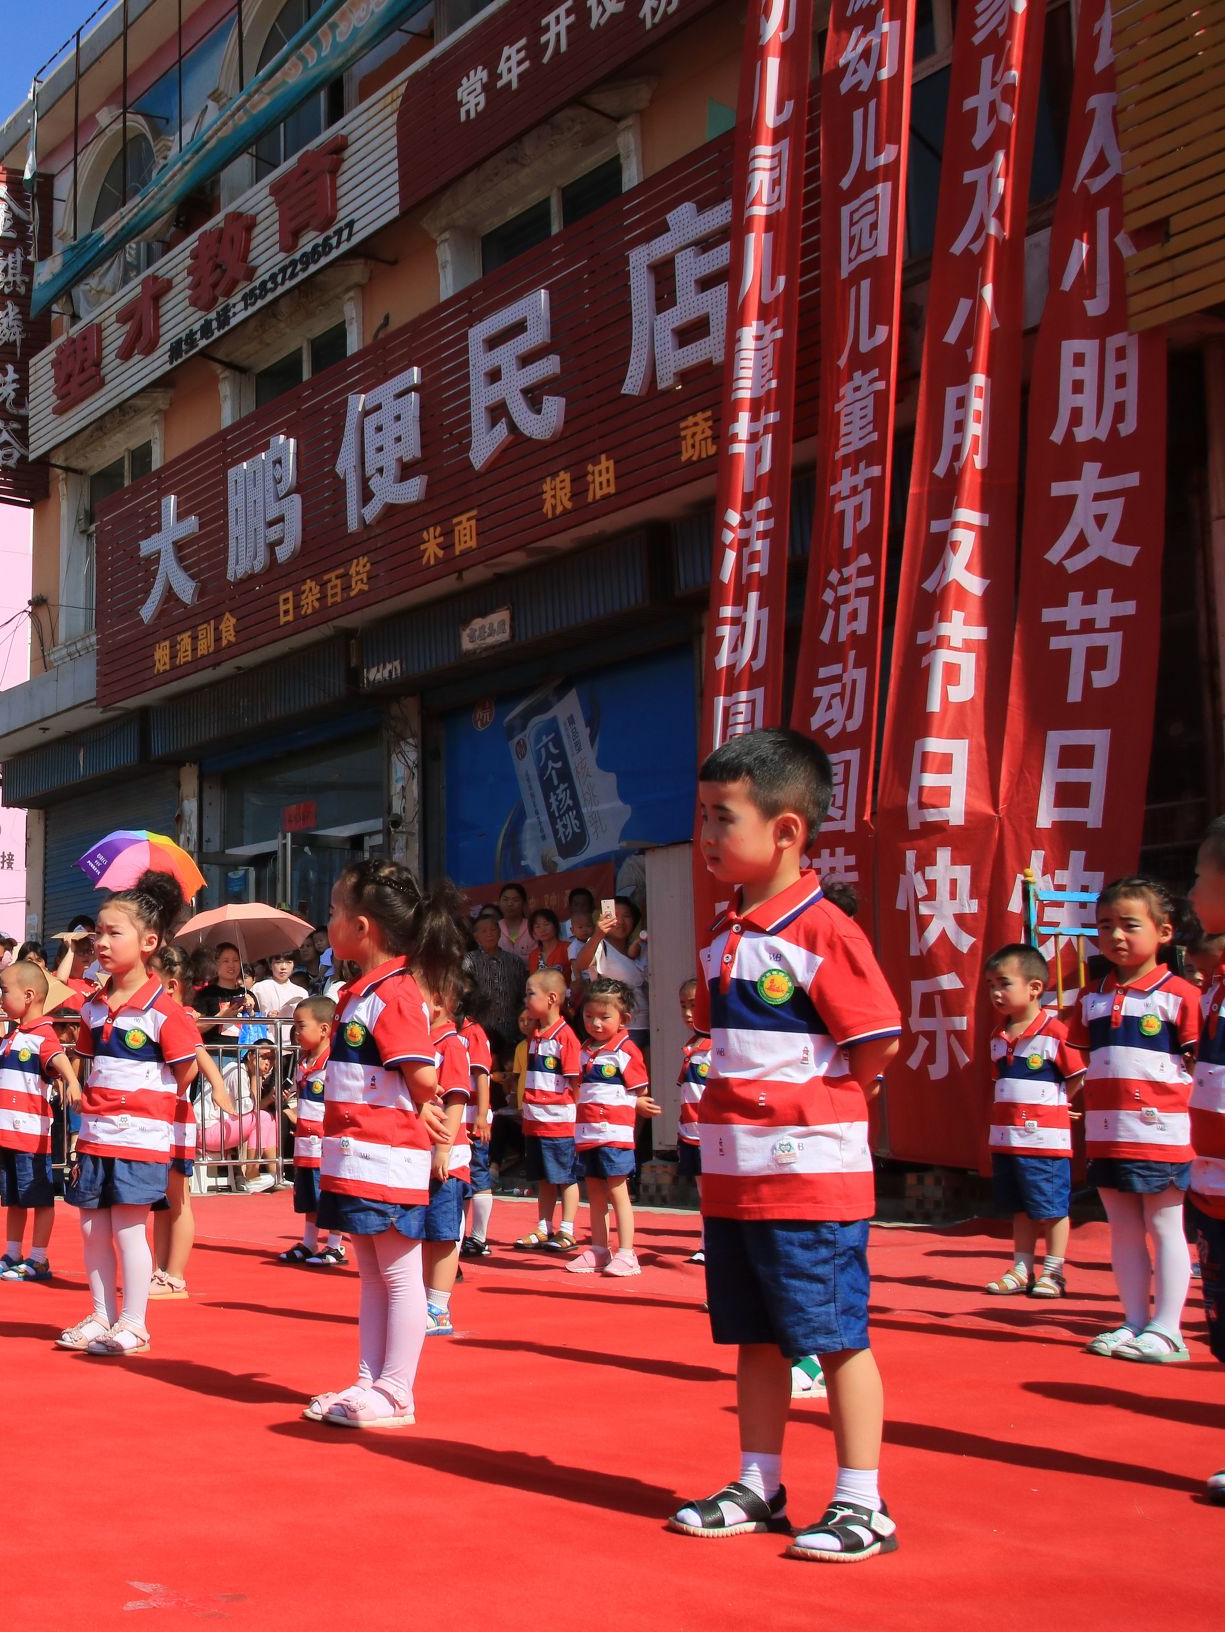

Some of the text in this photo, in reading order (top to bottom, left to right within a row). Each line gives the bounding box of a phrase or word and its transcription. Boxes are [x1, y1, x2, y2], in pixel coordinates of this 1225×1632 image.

[138, 201, 732, 625] 大鹏便民店
[153, 410, 718, 675] 烟酒副食 日杂百货 米面 粮油 蔬
[800, 0, 901, 884] 幼儿园儿童节活动圆
[534, 731, 582, 845] 六个核桃
